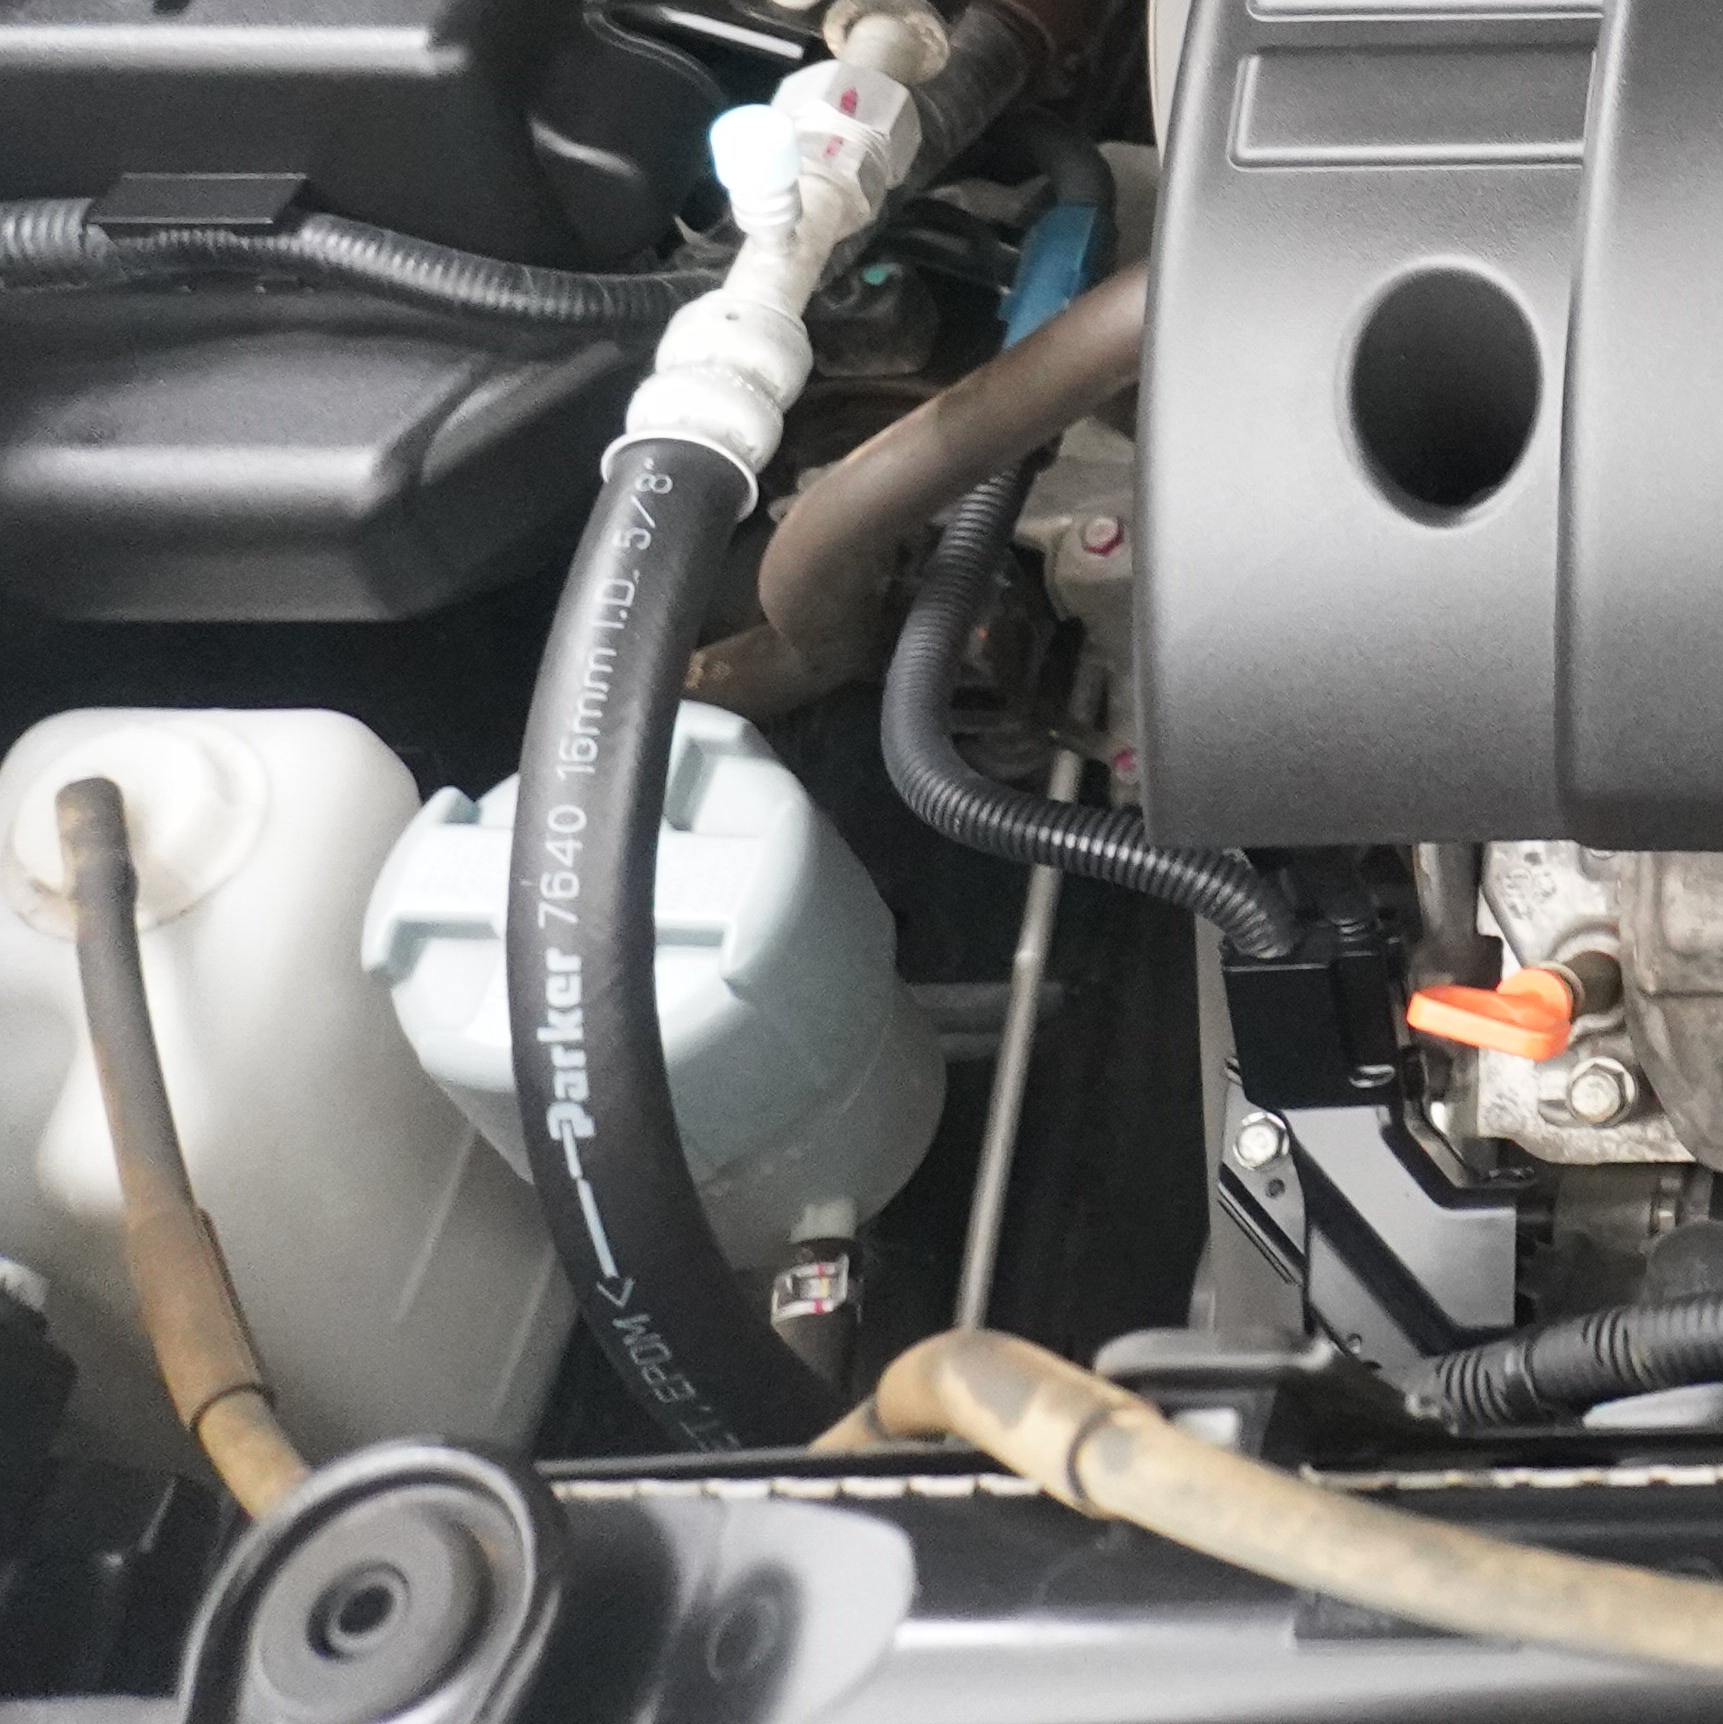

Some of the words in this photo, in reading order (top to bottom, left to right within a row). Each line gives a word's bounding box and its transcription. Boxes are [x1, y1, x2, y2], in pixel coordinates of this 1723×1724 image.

[557, 647, 618, 780] 16mm
[537, 803, 588, 929] 7640
[536, 945, 597, 1141] Parker
[611, 1312, 697, 1404] EPDM
